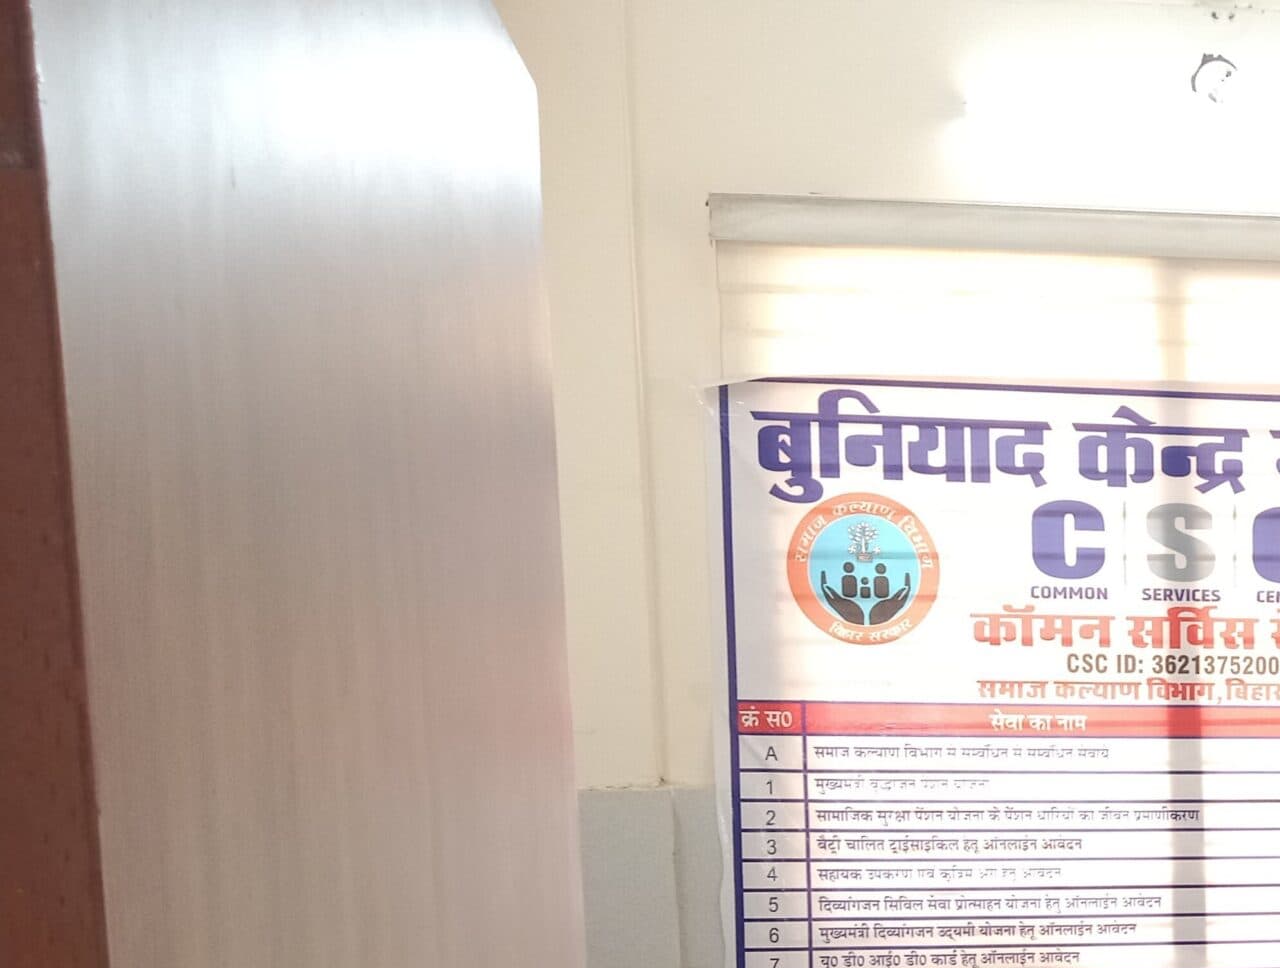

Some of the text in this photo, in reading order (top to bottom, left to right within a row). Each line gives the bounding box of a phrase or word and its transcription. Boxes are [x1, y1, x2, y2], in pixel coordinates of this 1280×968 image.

[750, 388, 1051, 503] बुनियाद
[1072, 405, 1250, 494] केन्द्र
[1030, 585, 1109, 601] COMMON
[1141, 588, 1221, 603] SERVICES
[969, 604, 1116, 647] कॉमन
[1126, 605, 1259, 650] सर्विस
[1067, 654, 1109, 675] CSC
[1116, 655, 1144, 675] ID:
[976, 680, 1048, 700] समाज
[1053, 680, 1142, 701] कल्याण
[989, 708, 1088, 731] सेवा का नाम
[764, 746, 778, 761] A
[813, 746, 850, 758] समाज
[766, 780, 773, 794] 1
[766, 810, 776, 825] 2
[766, 839, 778, 855] 3
[845, 835, 885, 851] चालित
[766, 867, 778, 882] 4
[768, 897, 779, 913] 5
[884, 896, 924, 911] सिविल
[769, 927, 780, 943] 6
[819, 923, 870, 943] मुख्यमंत्री
[979, 921, 1016, 937] योजना
[1097, 919, 1136, 934] आवेदन
[1040, 948, 1080, 964] आवेदन
